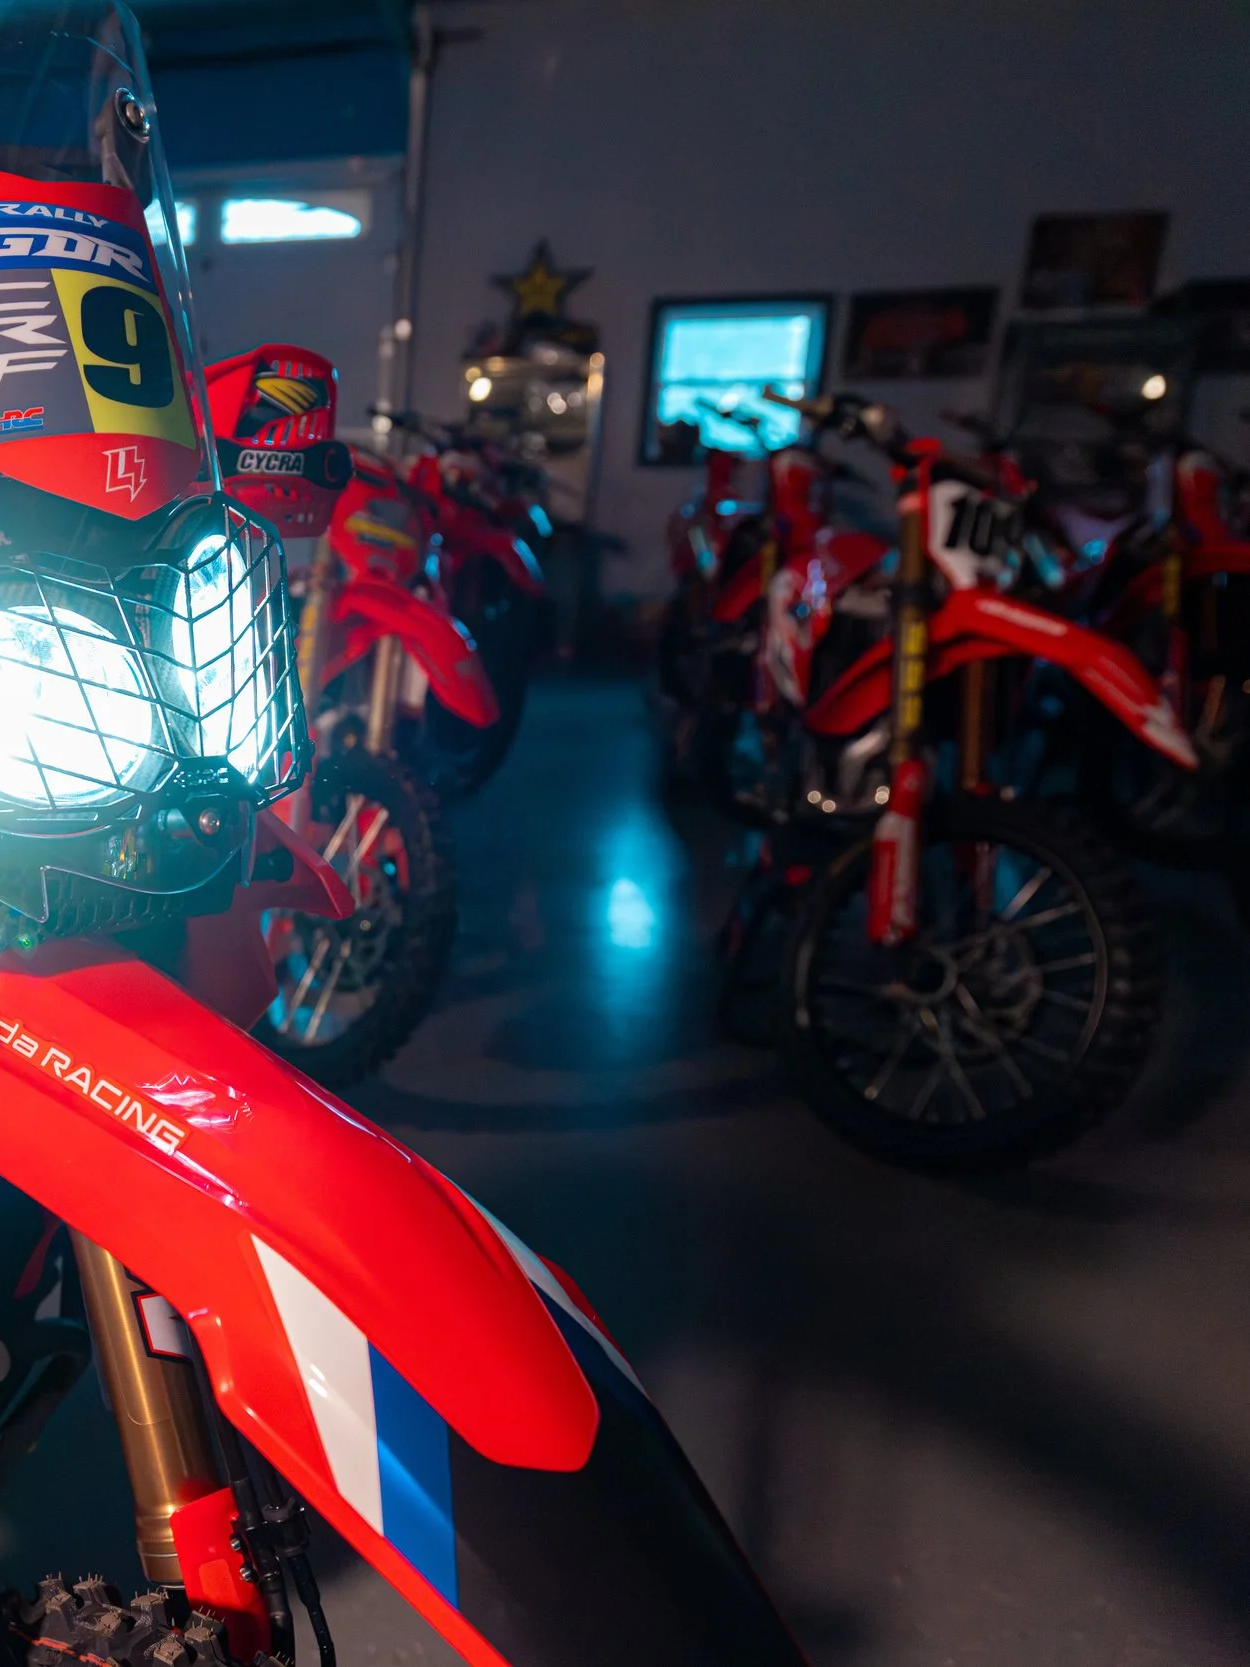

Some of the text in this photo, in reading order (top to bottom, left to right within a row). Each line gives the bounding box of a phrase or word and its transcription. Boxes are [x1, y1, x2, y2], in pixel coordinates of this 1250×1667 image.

[80, 285, 175, 409] 9
[236, 449, 304, 475] CYCRA
[40, 1047, 185, 1156] RACING
